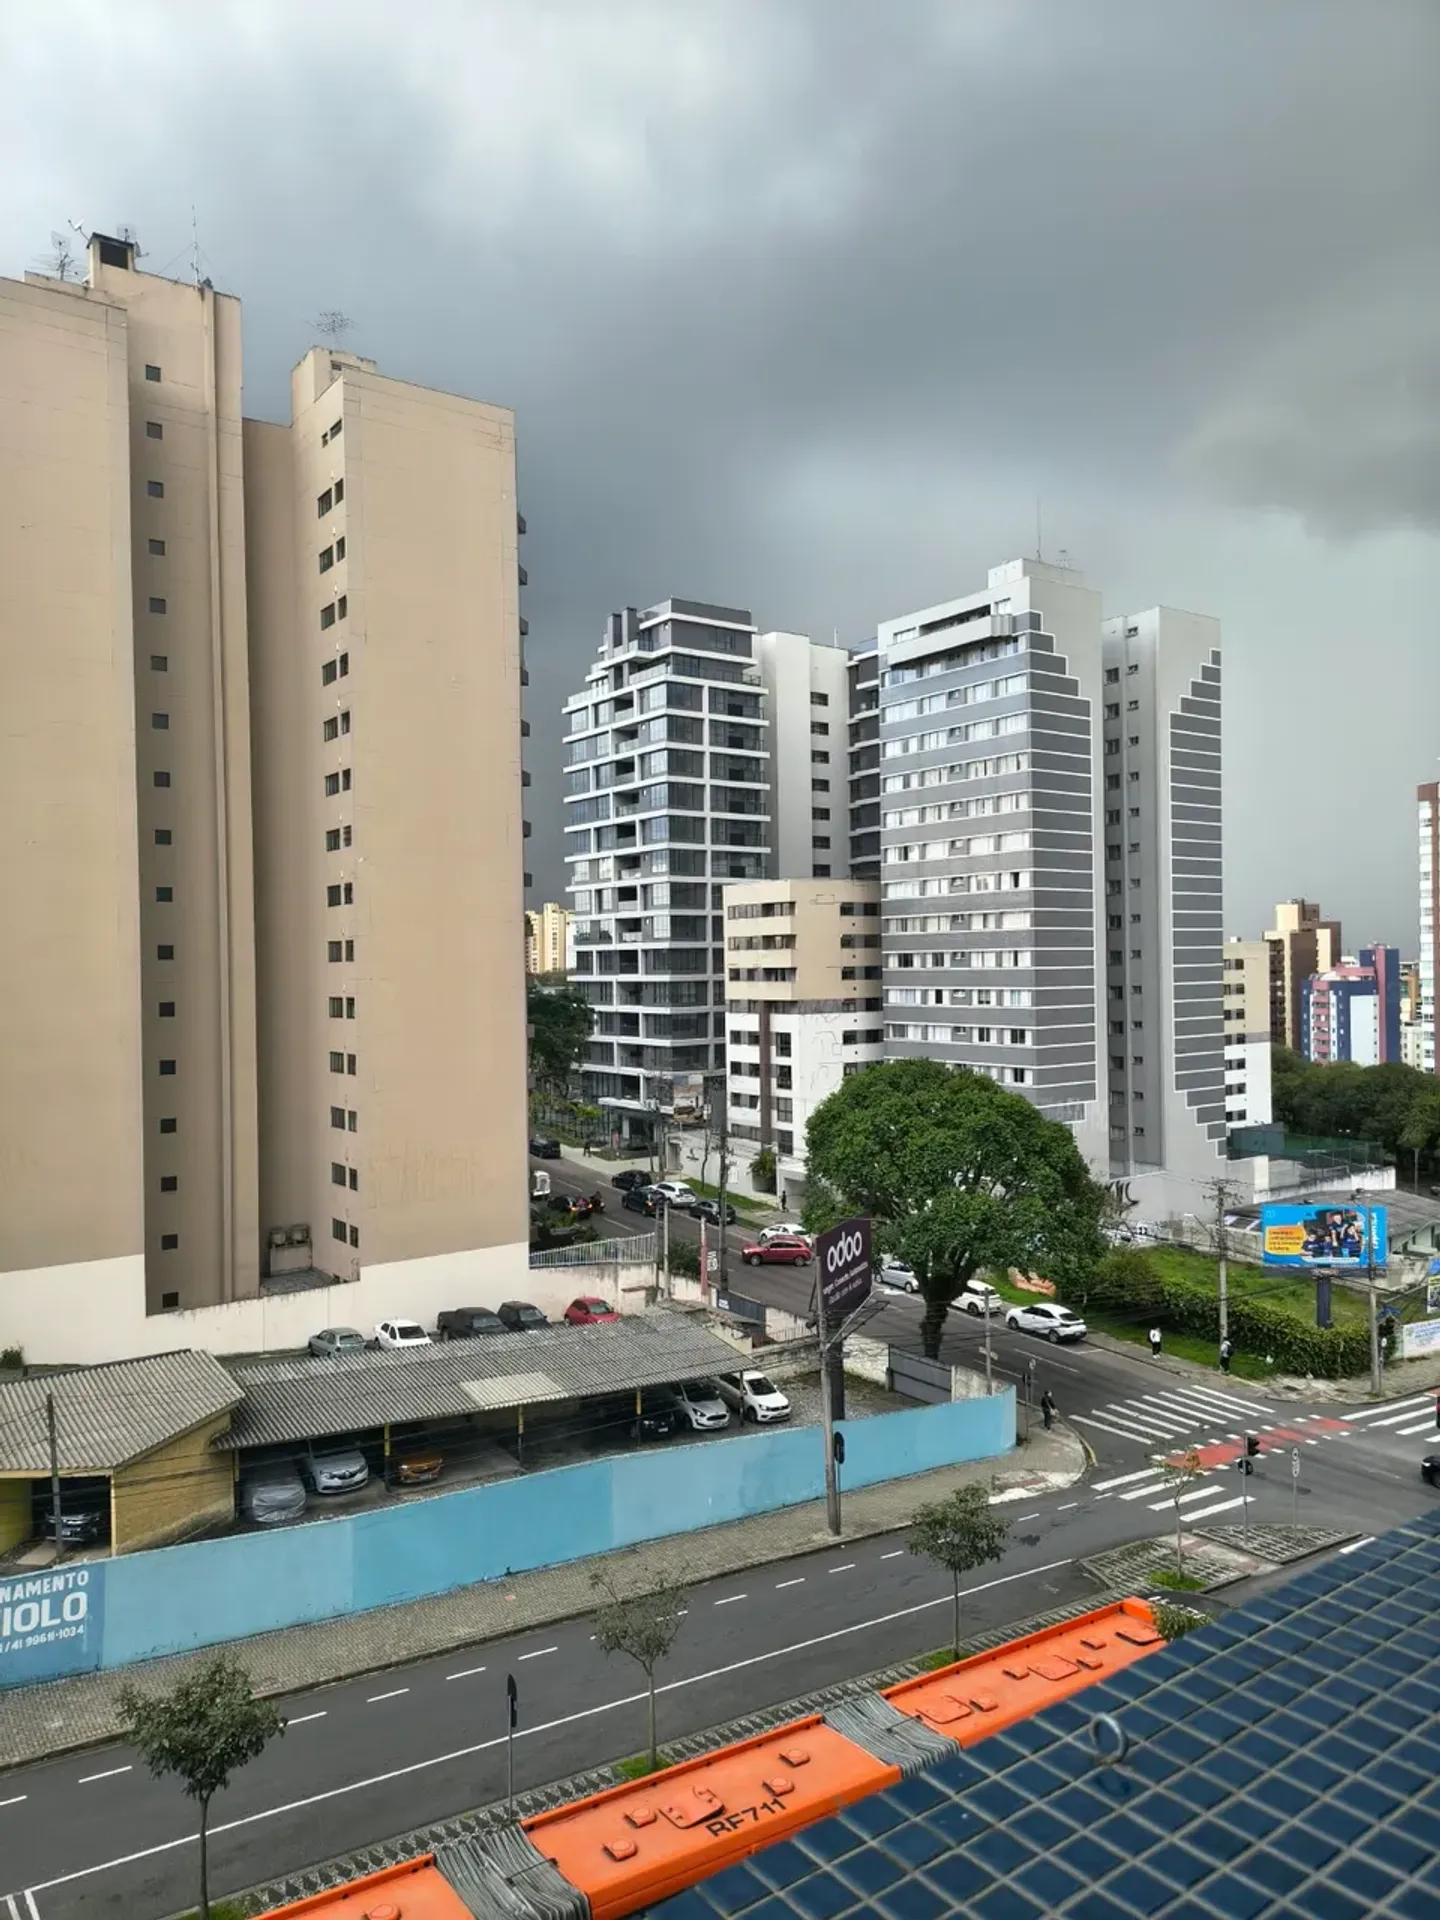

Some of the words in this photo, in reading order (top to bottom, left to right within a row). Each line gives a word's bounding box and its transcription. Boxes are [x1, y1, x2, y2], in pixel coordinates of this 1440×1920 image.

[827, 1231, 862, 1273] odoo
[0, 1570, 89, 1604] NAMENTO
[705, 1798, 786, 1836] RF711
